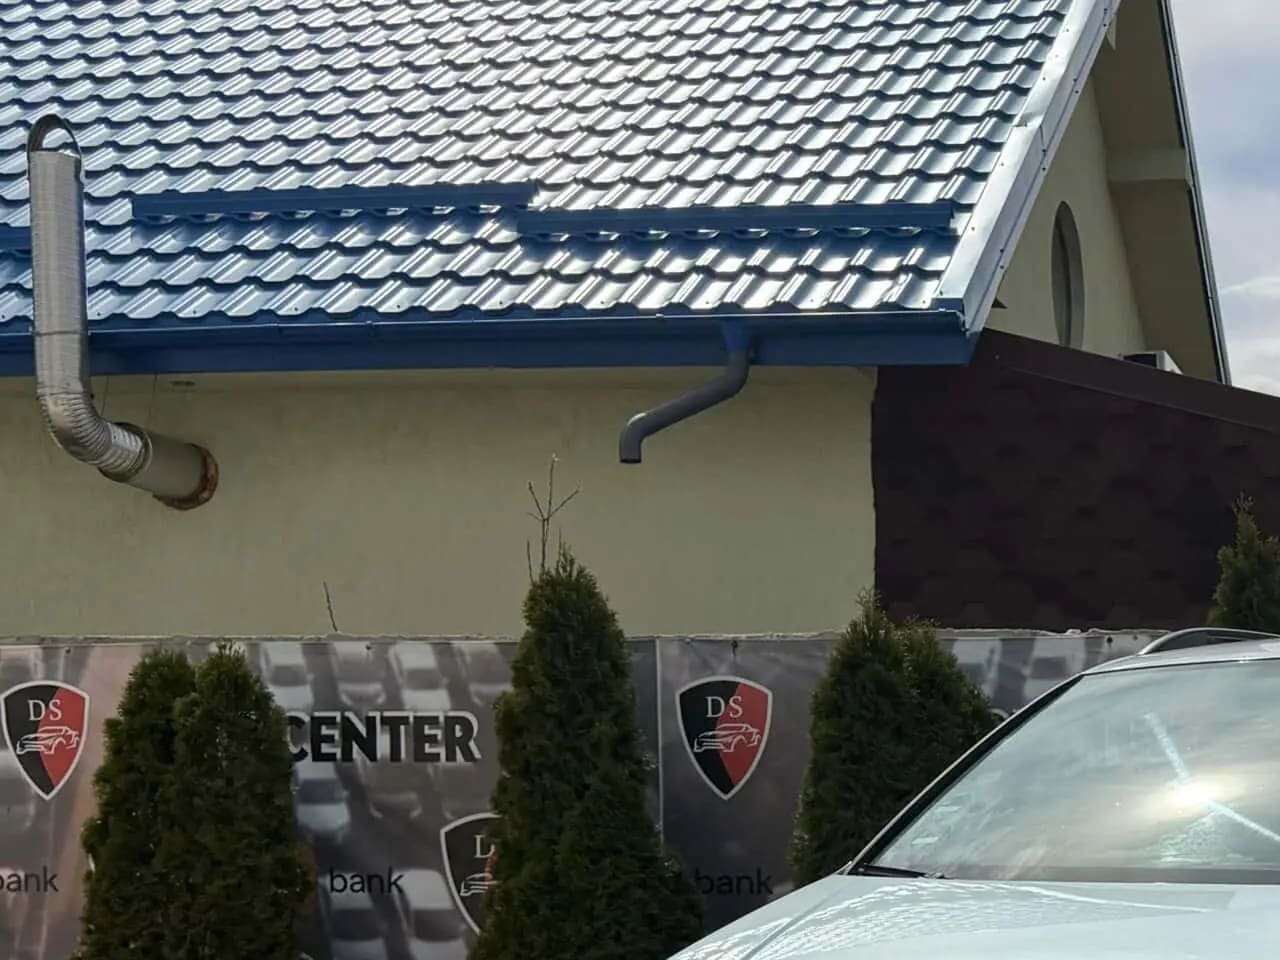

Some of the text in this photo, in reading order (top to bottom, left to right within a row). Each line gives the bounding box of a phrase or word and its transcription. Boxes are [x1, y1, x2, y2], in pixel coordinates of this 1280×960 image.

[28, 699, 62, 721] DS
[706, 695, 744, 718] DS
[287, 712, 482, 763] CENTER
[0, 865, 59, 892] ank
[329, 866, 404, 893] bank
[696, 867, 773, 894] bank
